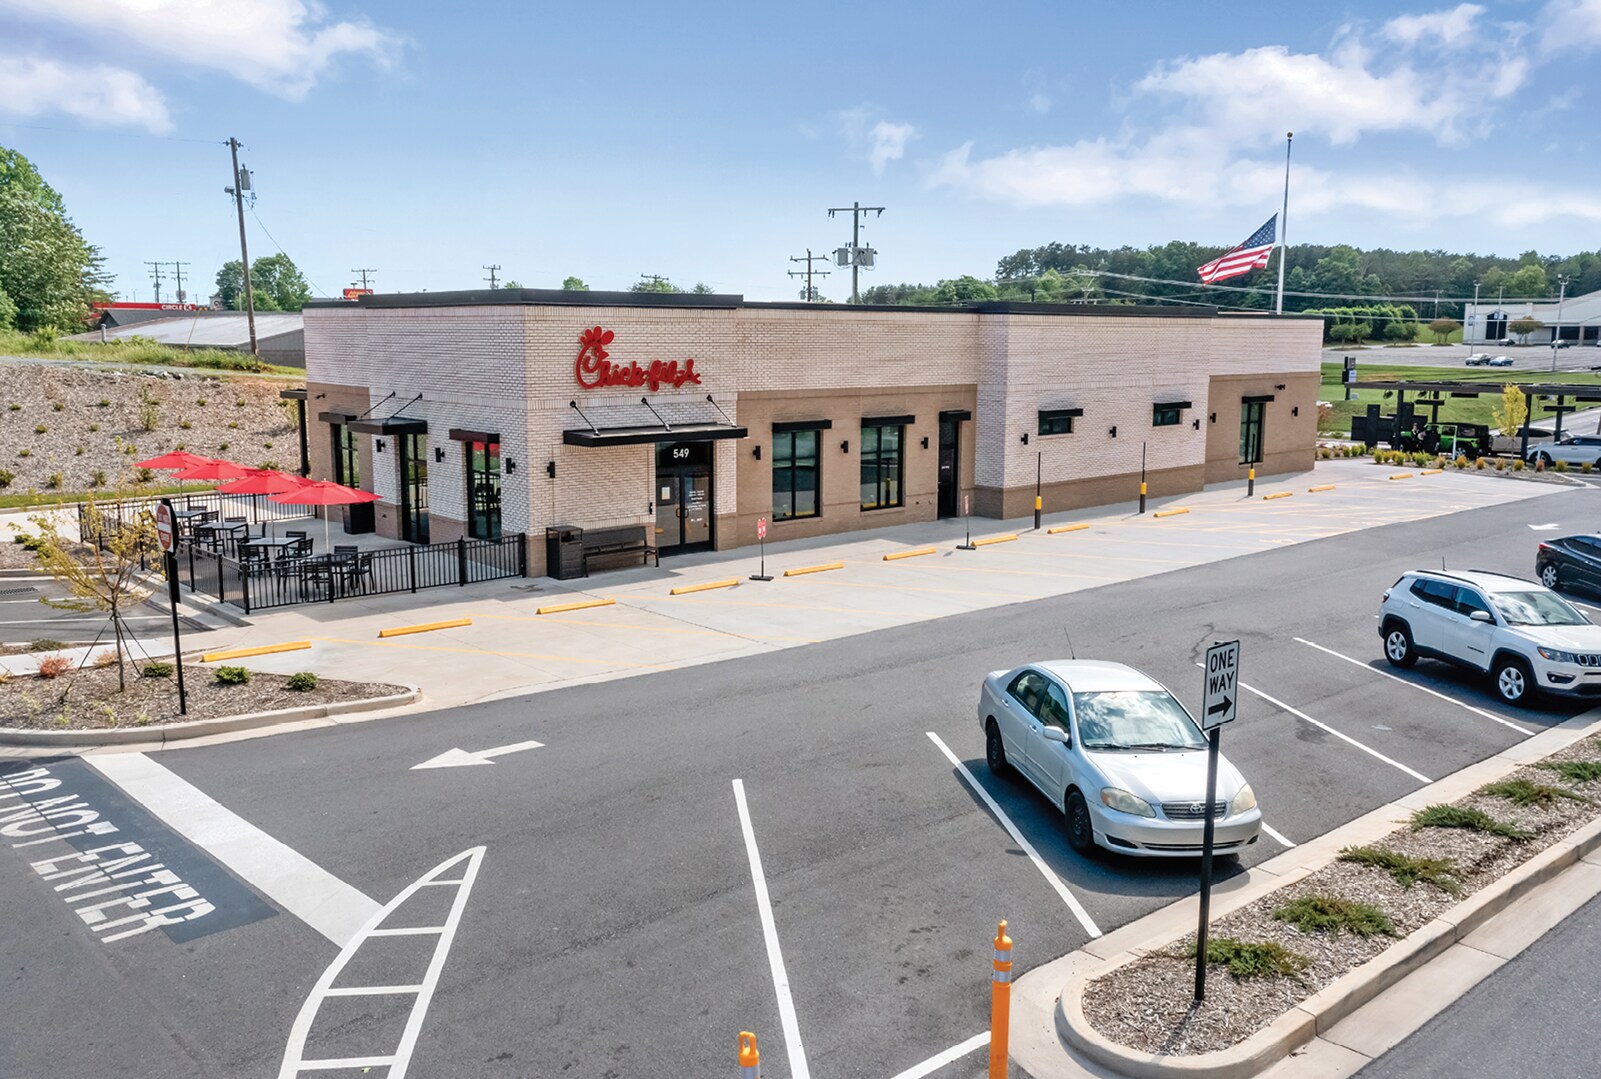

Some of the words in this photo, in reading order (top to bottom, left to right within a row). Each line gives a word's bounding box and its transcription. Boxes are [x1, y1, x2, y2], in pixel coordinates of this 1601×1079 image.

[575, 326, 702, 392] Chick-fil-A
[673, 448, 690, 459] 549
[1210, 648, 1235, 673] ONE
[1210, 671, 1235, 695] WAY
[0, 794, 119, 848] NOT
[29, 841, 216, 943] ENTER
